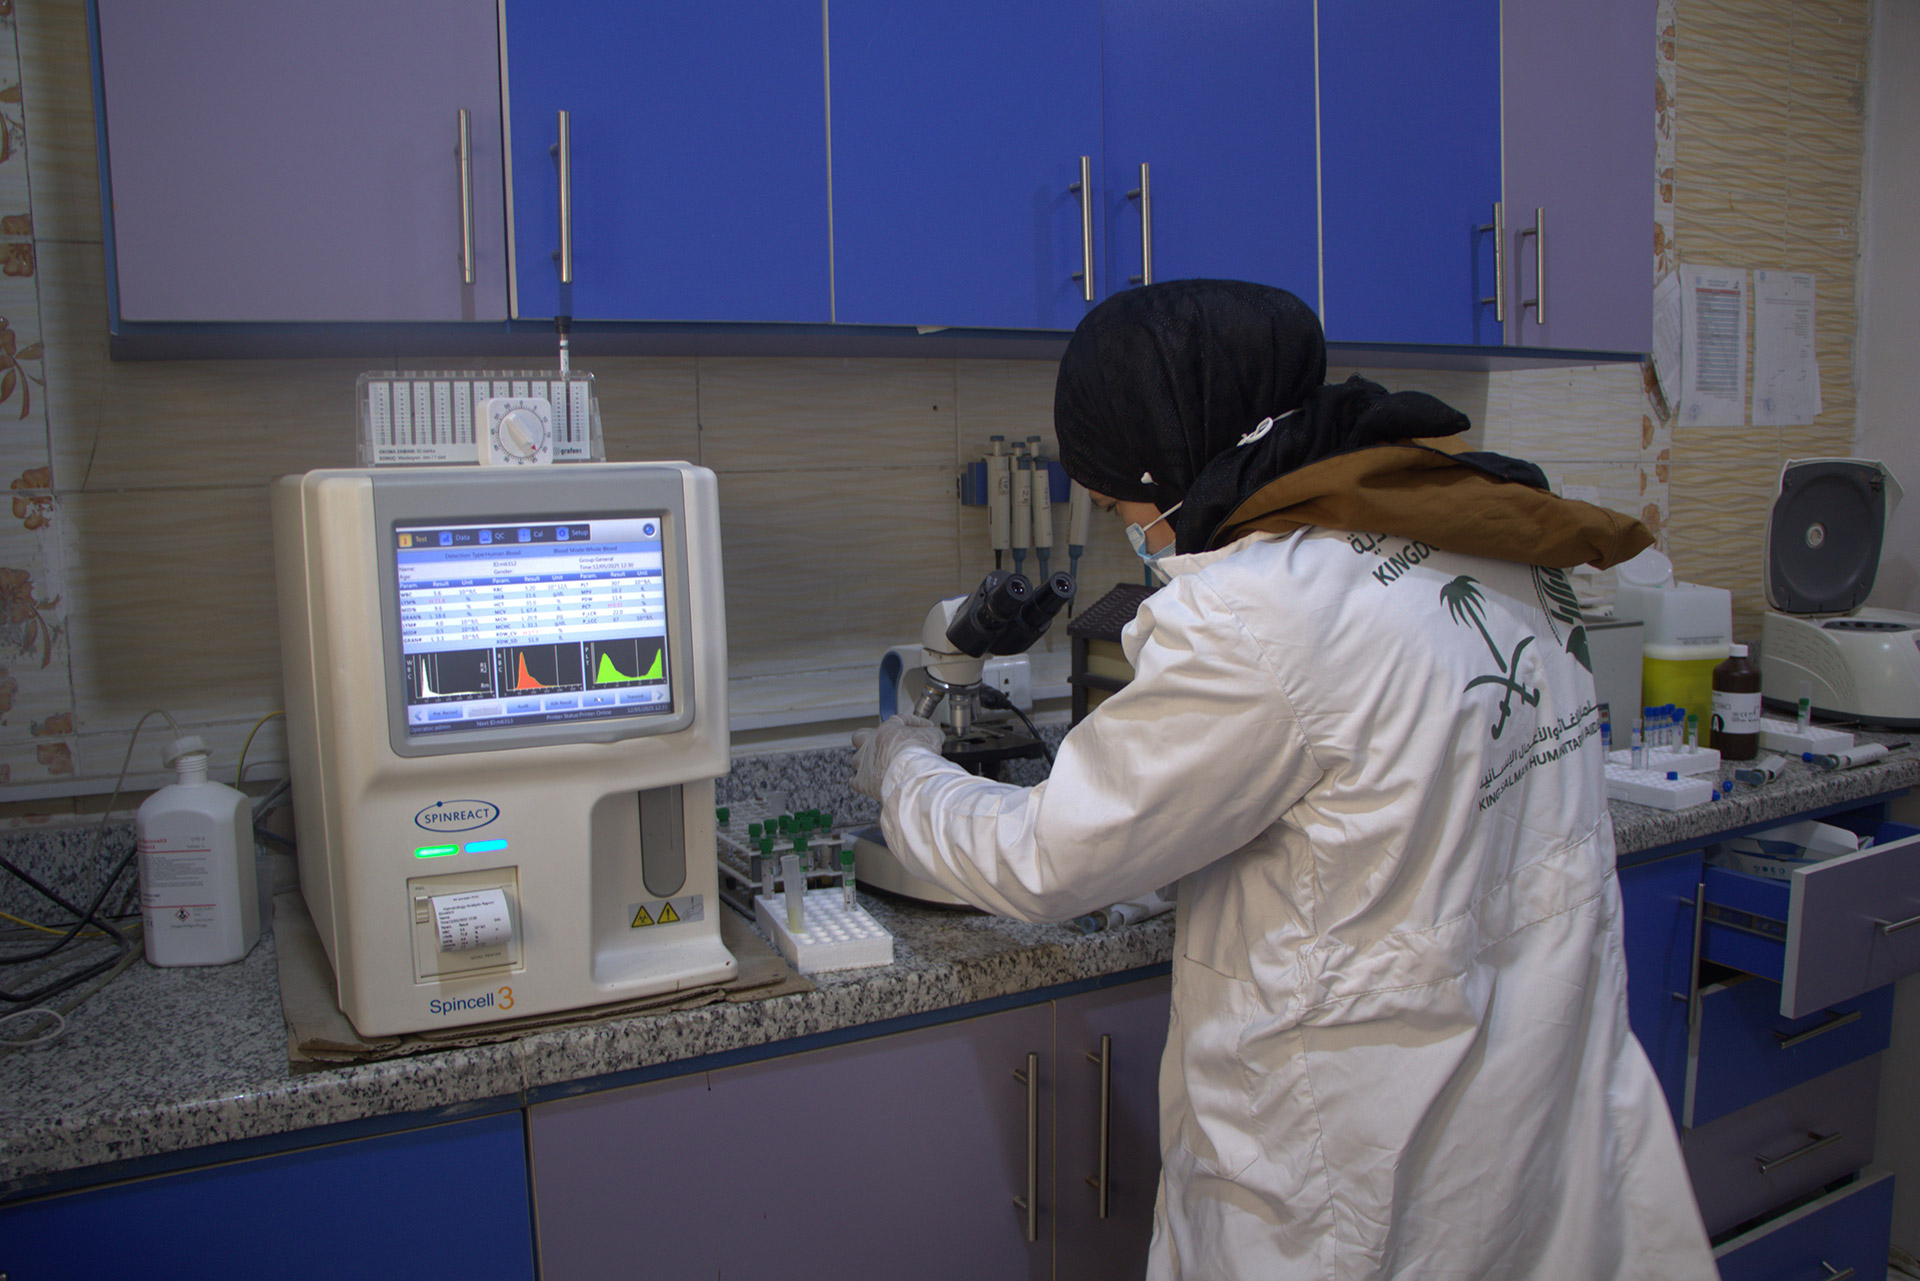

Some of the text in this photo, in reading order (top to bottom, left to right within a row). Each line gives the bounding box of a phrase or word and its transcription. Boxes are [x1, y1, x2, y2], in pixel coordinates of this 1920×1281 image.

[1479, 788, 1500, 811] KING
[424, 808, 489, 824] SPINREACT
[430, 986, 514, 1015] Spincell 3
